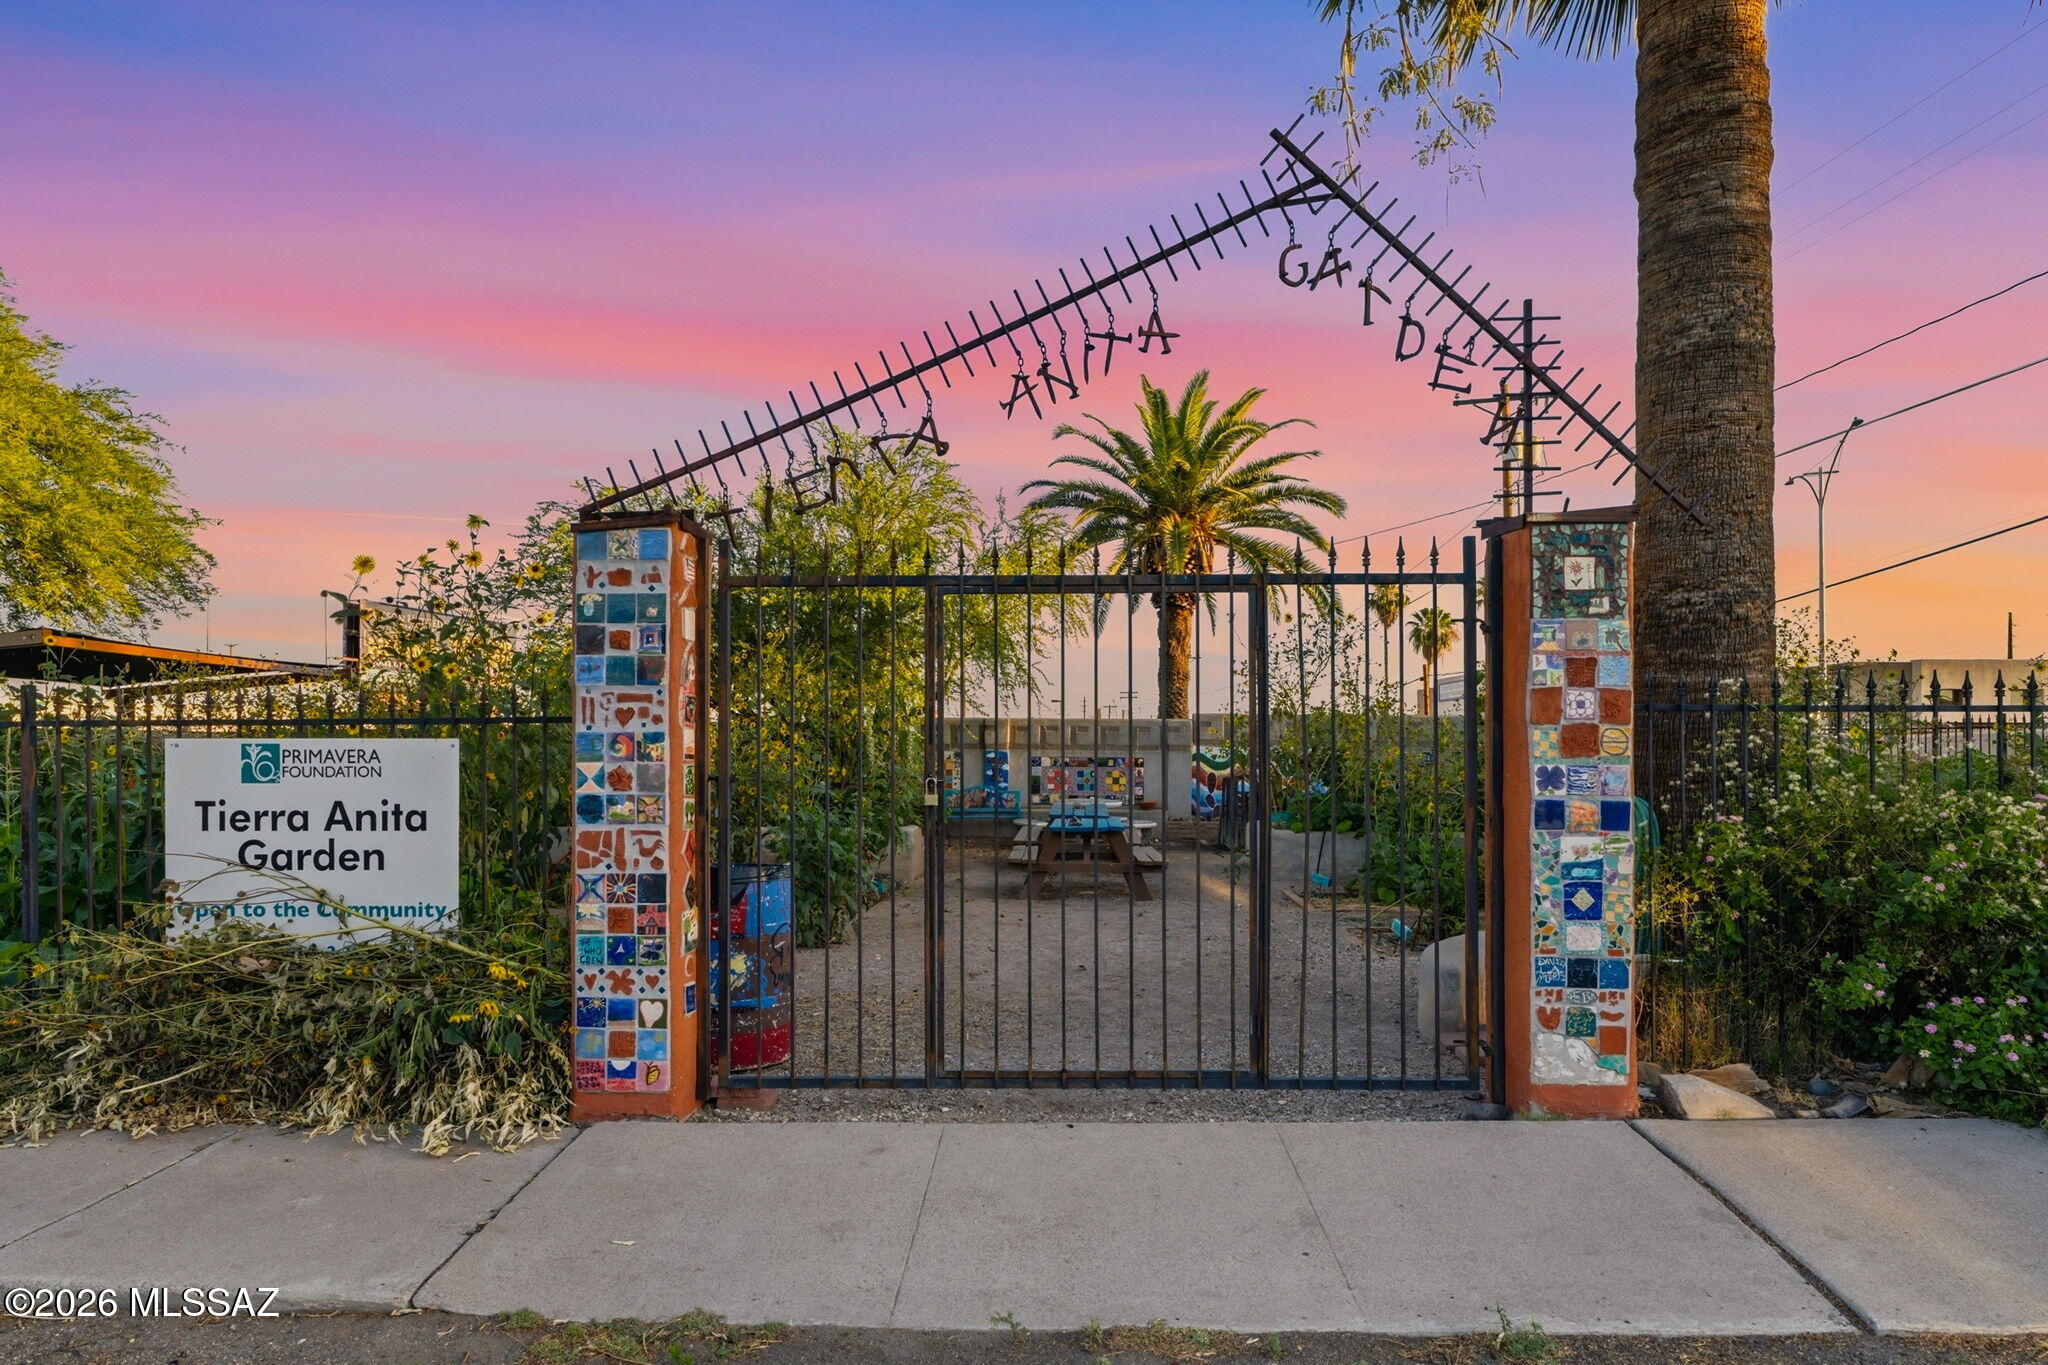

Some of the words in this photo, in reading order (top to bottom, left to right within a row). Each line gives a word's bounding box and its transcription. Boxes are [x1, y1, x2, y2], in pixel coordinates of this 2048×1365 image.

[1000, 311, 1181, 420] ANITA
[1279, 243, 1525, 454] GARDEN
[282, 749, 382, 764] PRIMAVERA
[282, 766, 382, 778] FOUNDATION
[195, 799, 309, 832] Tierra
[324, 799, 428, 832] Anita
[238, 838, 385, 871] Garden
[243, 903, 266, 917] to
[273, 902, 309, 917] the
